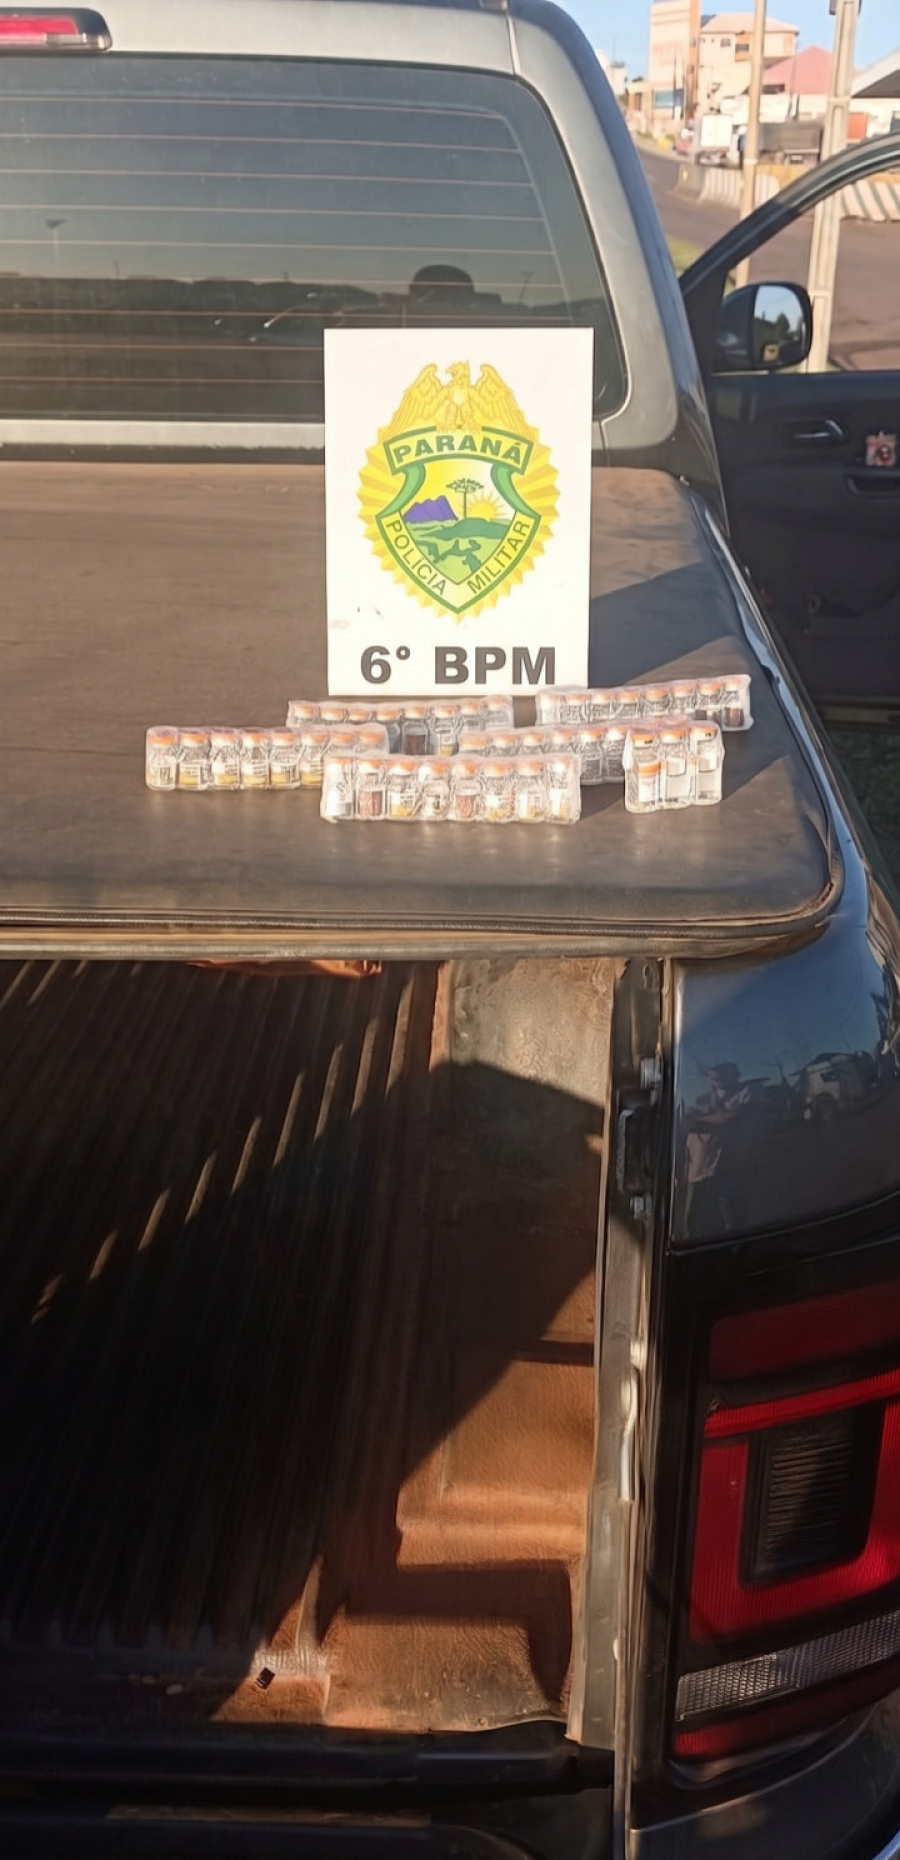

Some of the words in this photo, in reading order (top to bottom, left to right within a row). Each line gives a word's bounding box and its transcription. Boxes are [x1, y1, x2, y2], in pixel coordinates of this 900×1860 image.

[392, 435, 522, 464] PARANÁ
[385, 519, 447, 596] POLÍCIA
[467, 520, 531, 596] MILITAR
[434, 646, 556, 685] BPM
